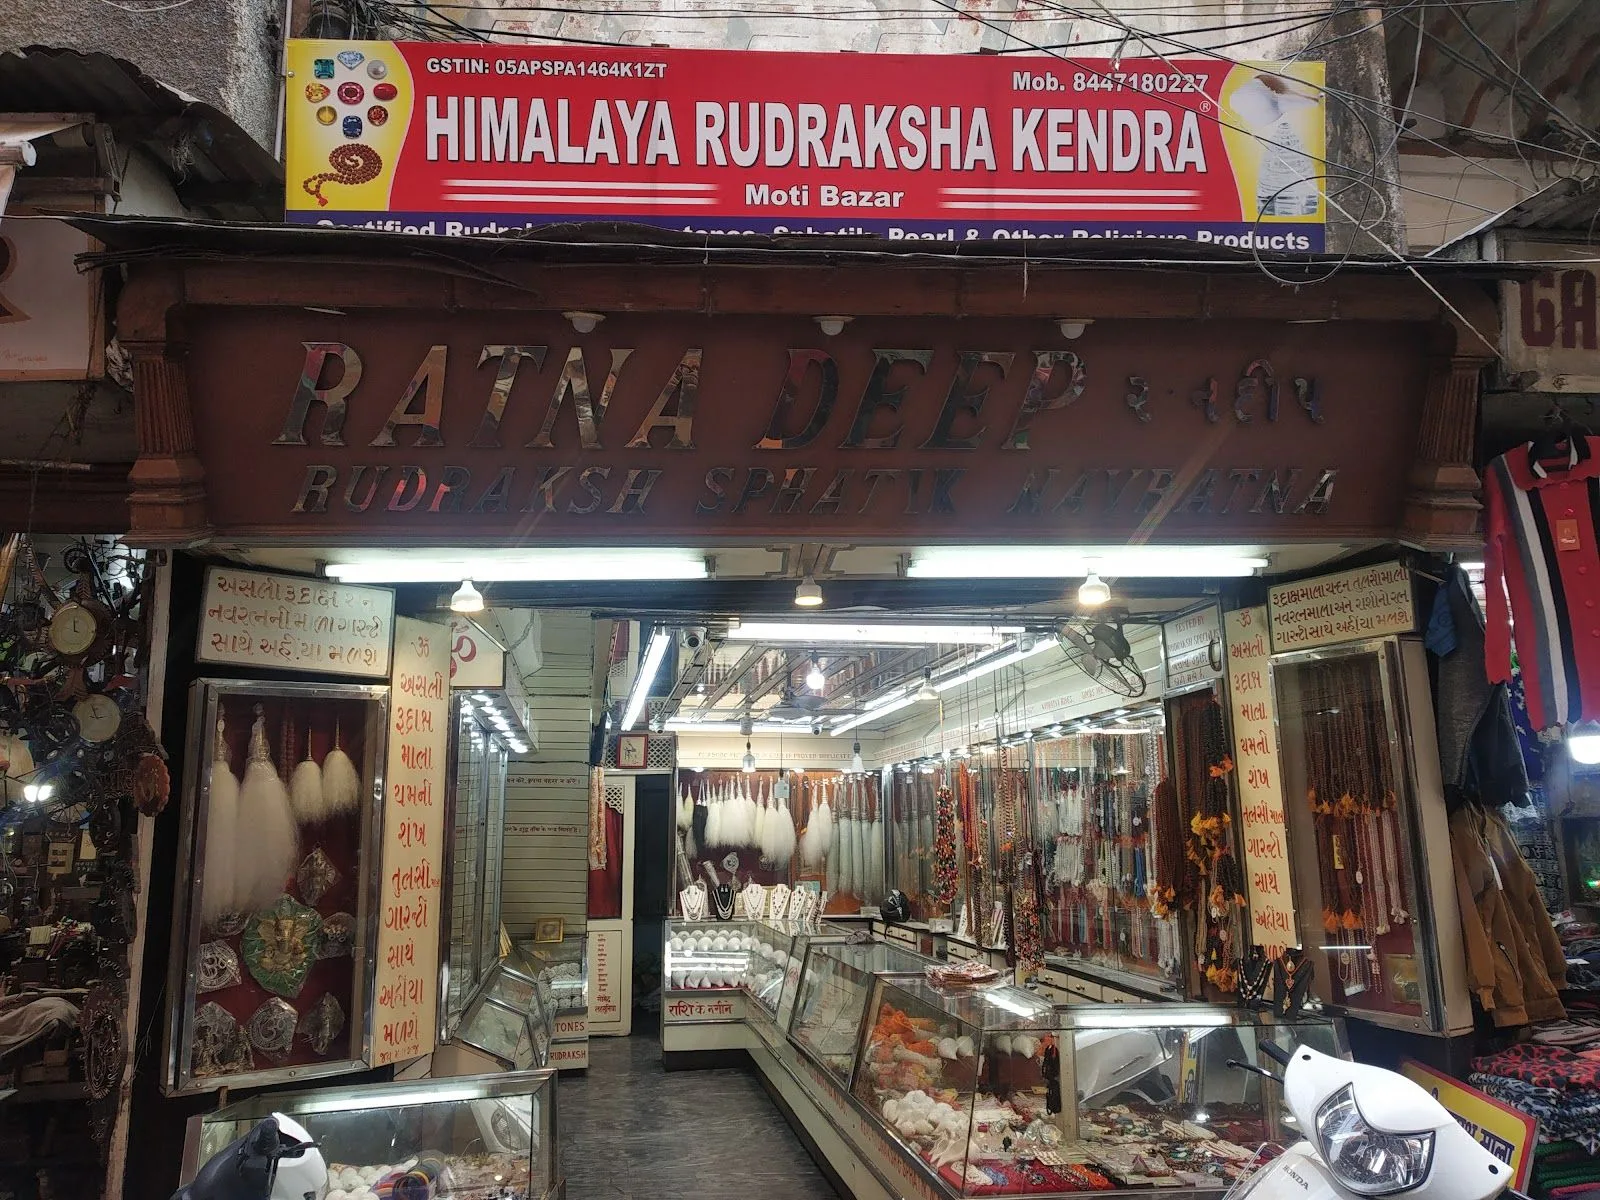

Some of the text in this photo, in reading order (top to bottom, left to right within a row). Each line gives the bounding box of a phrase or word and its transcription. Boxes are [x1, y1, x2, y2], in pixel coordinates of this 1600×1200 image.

[426, 57, 668, 79] GSTIN: 05APSPA1464K1ZT
[1012, 72, 1209, 93] Mob. 8447180227
[425, 95, 1208, 173] HIMALAYA RUDRAKSHA KENDRA
[744, 183, 904, 208] Moti Bazar
[1198, 229, 1310, 250] Products
[271, 341, 1088, 450] RATNA DEEP
[290, 464, 1341, 515] RUDRAKSH SPHATIK NAVRATNA
[669, 1001, 694, 1018] राशि
[550, 1050, 586, 1061] RUDRAKSH
[1282, 1164, 1309, 1191] HONDA
